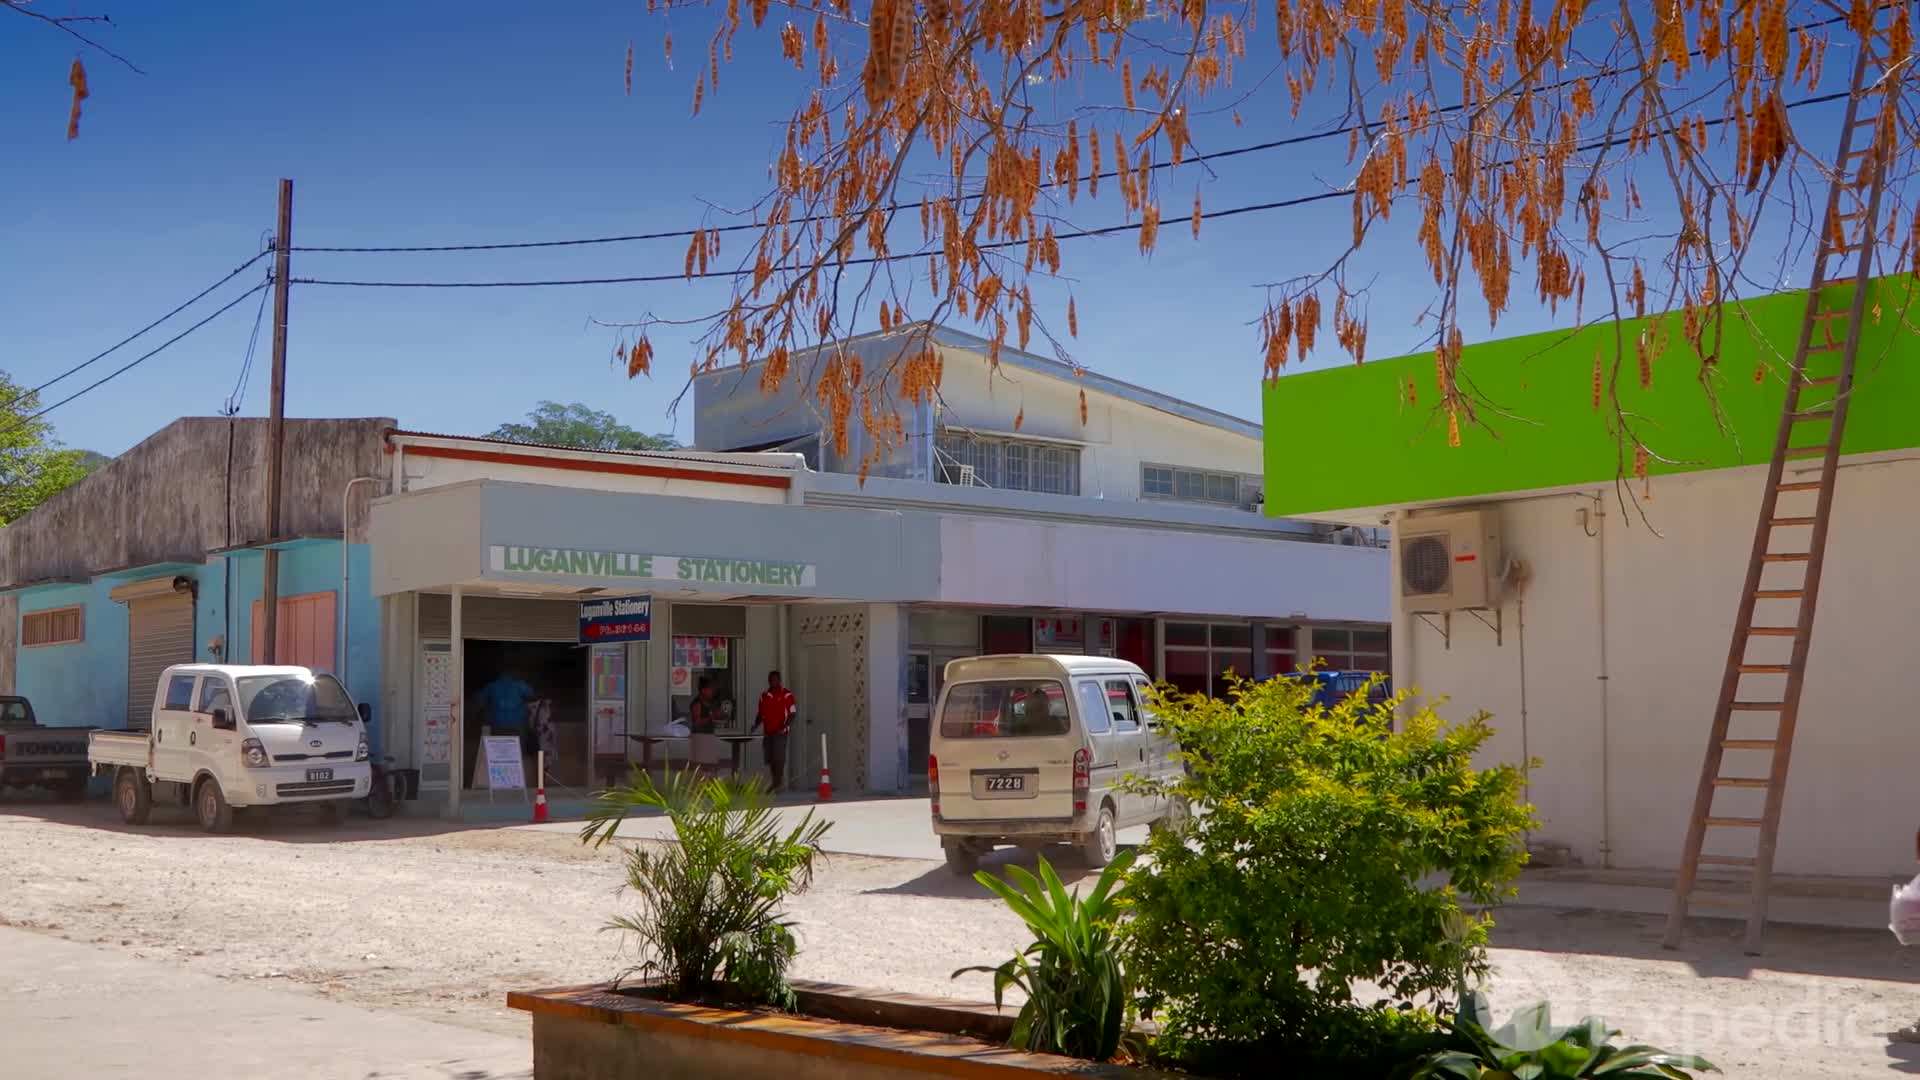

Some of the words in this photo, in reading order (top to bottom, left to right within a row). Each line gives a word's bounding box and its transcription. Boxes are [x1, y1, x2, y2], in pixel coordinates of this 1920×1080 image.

[503, 547, 652, 577] LUGANVILLE
[677, 558, 806, 586] STATIONERY
[614, 599, 649, 617] Stationery
[989, 778, 1021, 789] 7228
